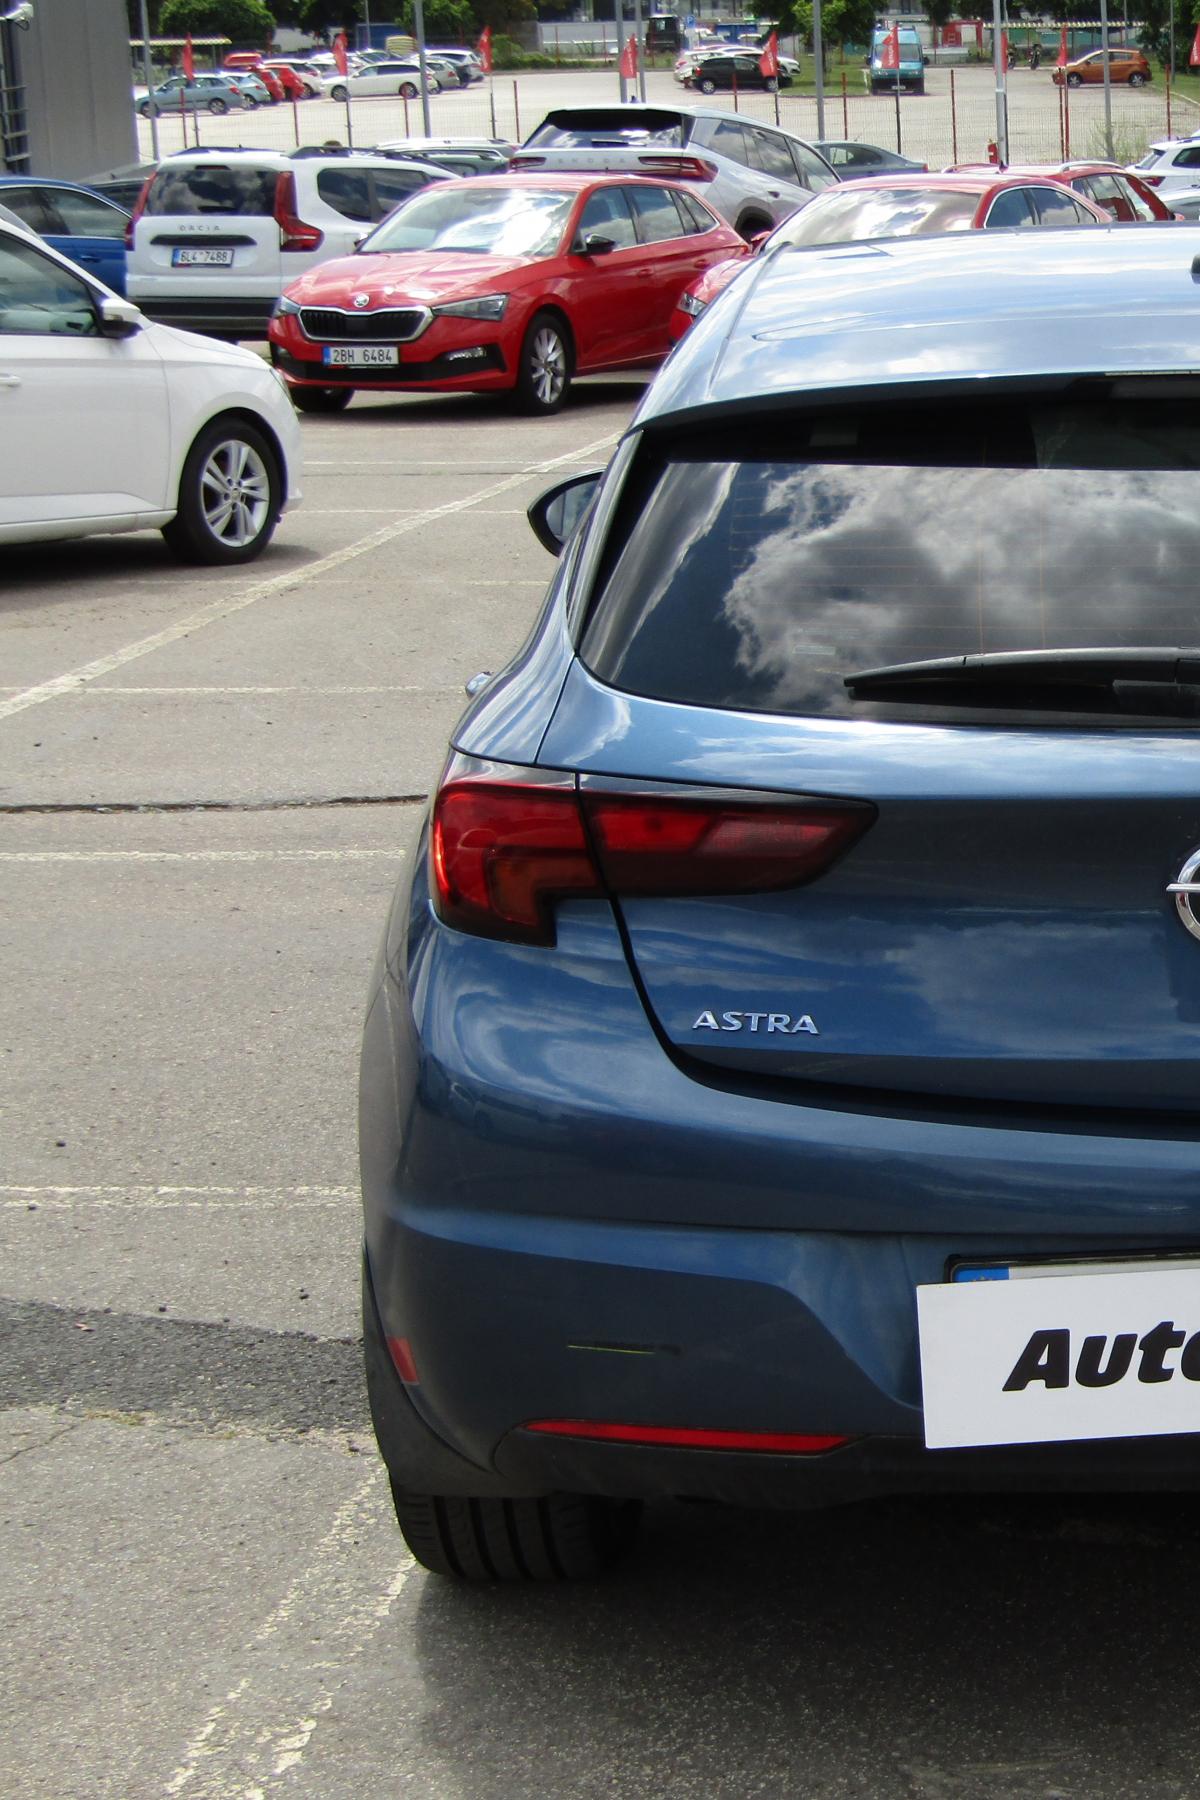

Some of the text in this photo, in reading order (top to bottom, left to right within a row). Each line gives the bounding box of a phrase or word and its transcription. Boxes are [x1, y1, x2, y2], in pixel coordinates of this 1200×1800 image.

[333, 349, 392, 363] 2BH 6484
[692, 1010, 820, 1035] ASTRA
